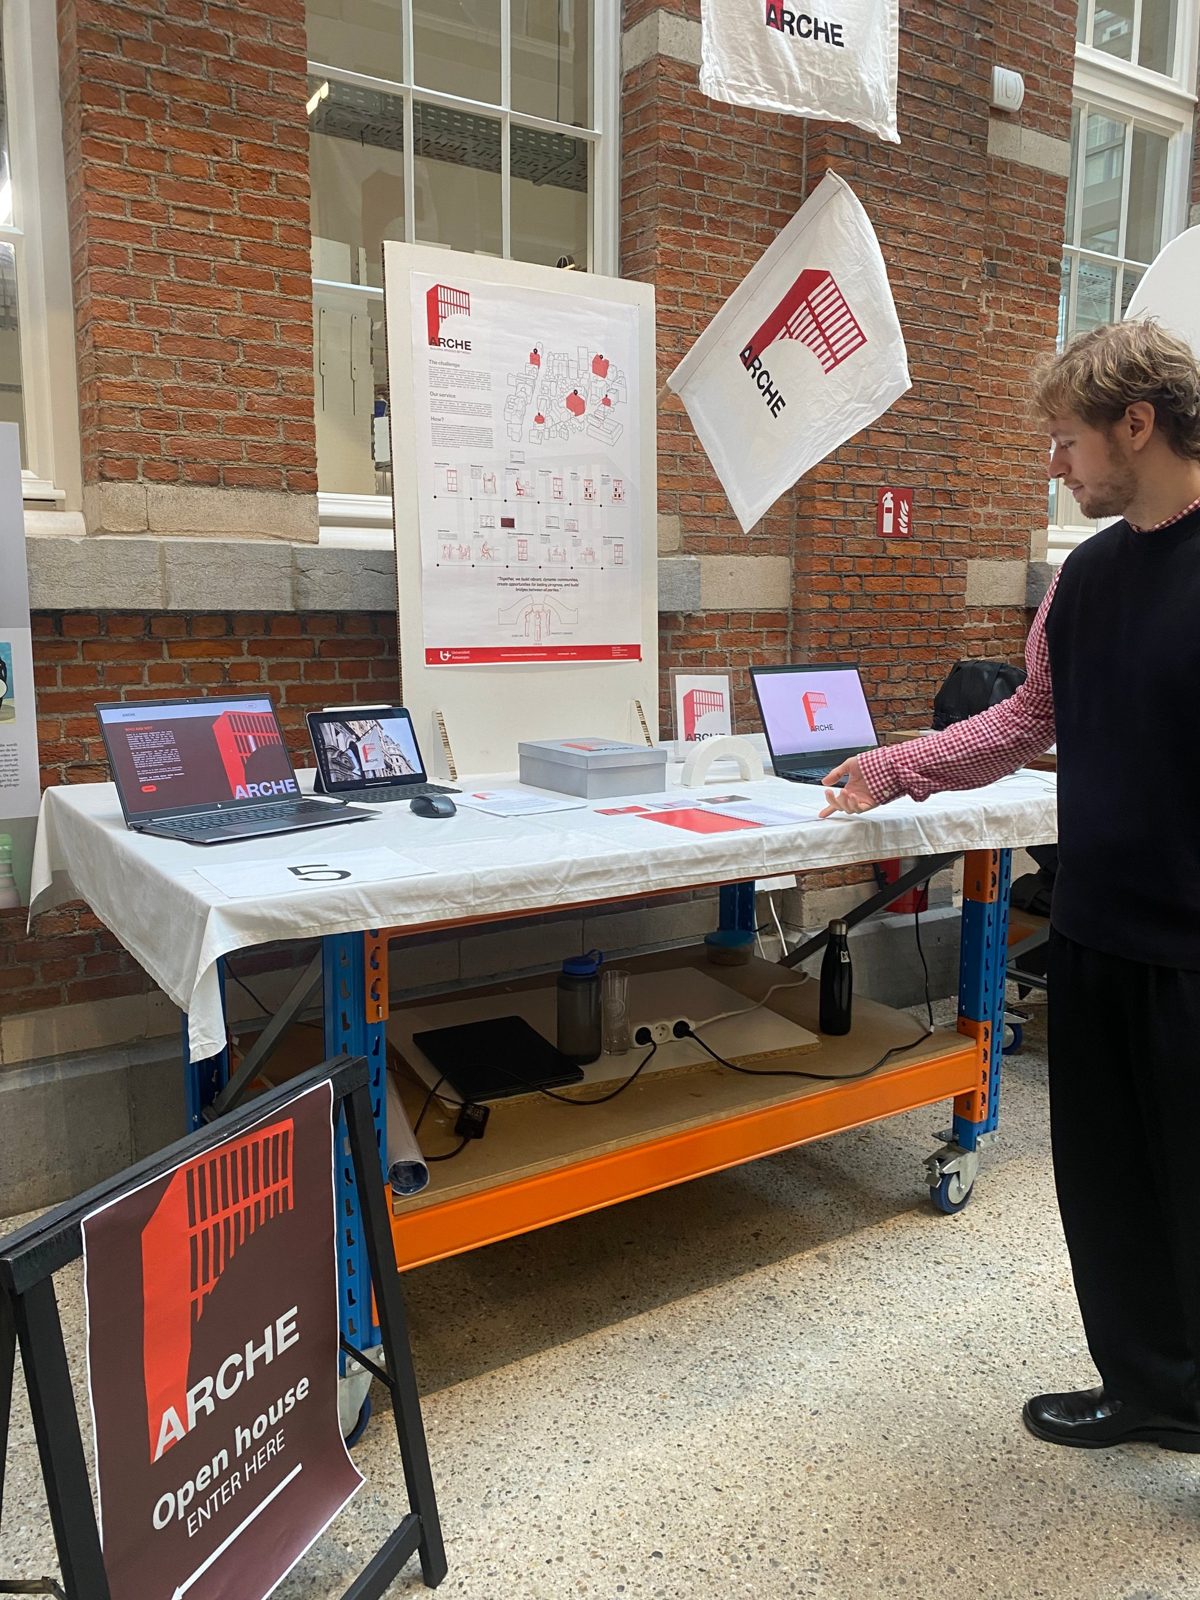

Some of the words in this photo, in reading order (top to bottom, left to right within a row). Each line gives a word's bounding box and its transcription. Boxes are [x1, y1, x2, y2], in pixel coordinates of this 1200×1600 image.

[766, 4, 845, 48] ARCHE
[429, 336, 472, 351] ARCHE
[739, 345, 787, 419] ARCHE
[685, 732, 726, 742] ARC
[810, 723, 835, 732] ARCHE
[235, 778, 298, 800] ARCHE
[286, 864, 352, 881] 5
[153, 1305, 300, 1463] ARCHE
[152, 1448, 229, 1531] Open
[235, 1376, 309, 1457] house
[186, 1472, 242, 1538] ENTER
[245, 1428, 286, 1482] HERE
